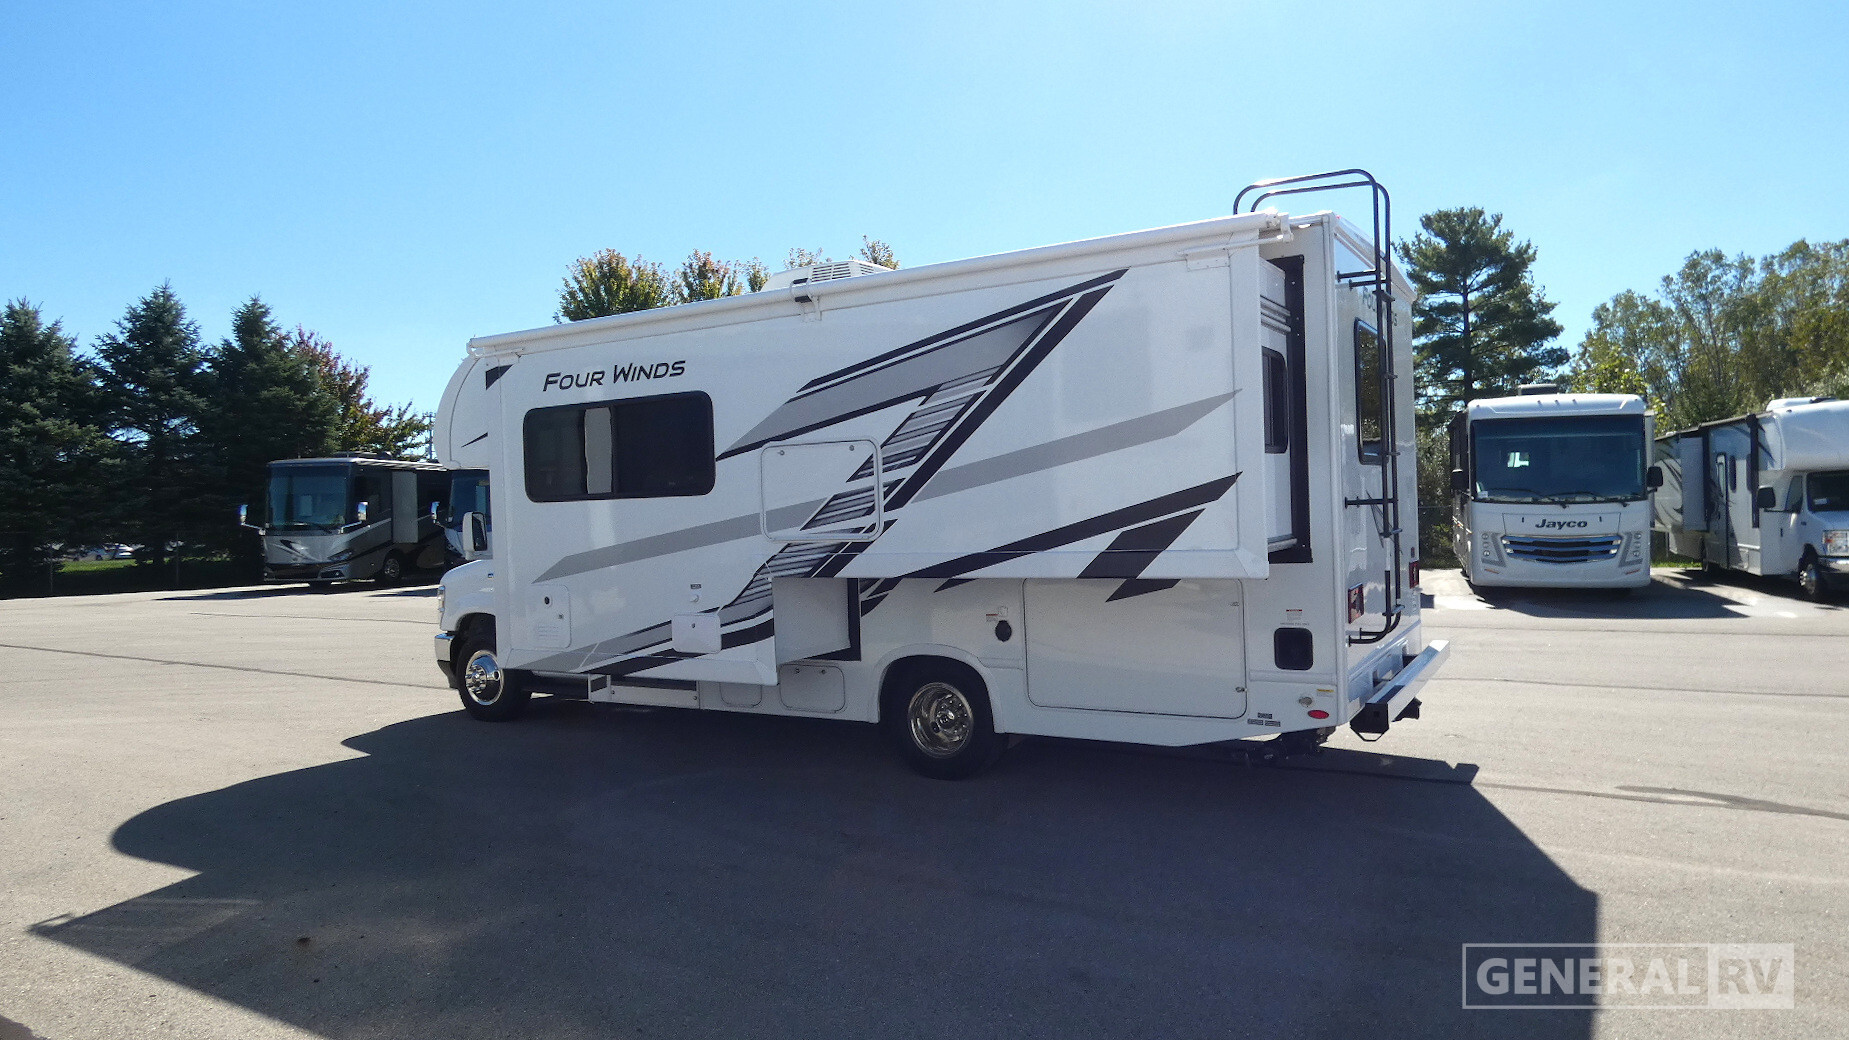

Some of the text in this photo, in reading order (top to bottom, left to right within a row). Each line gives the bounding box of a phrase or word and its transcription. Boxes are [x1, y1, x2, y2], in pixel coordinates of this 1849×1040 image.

[543, 360, 686, 392] FOUR WINDS
[1535, 519, 1588, 530] Jayco
